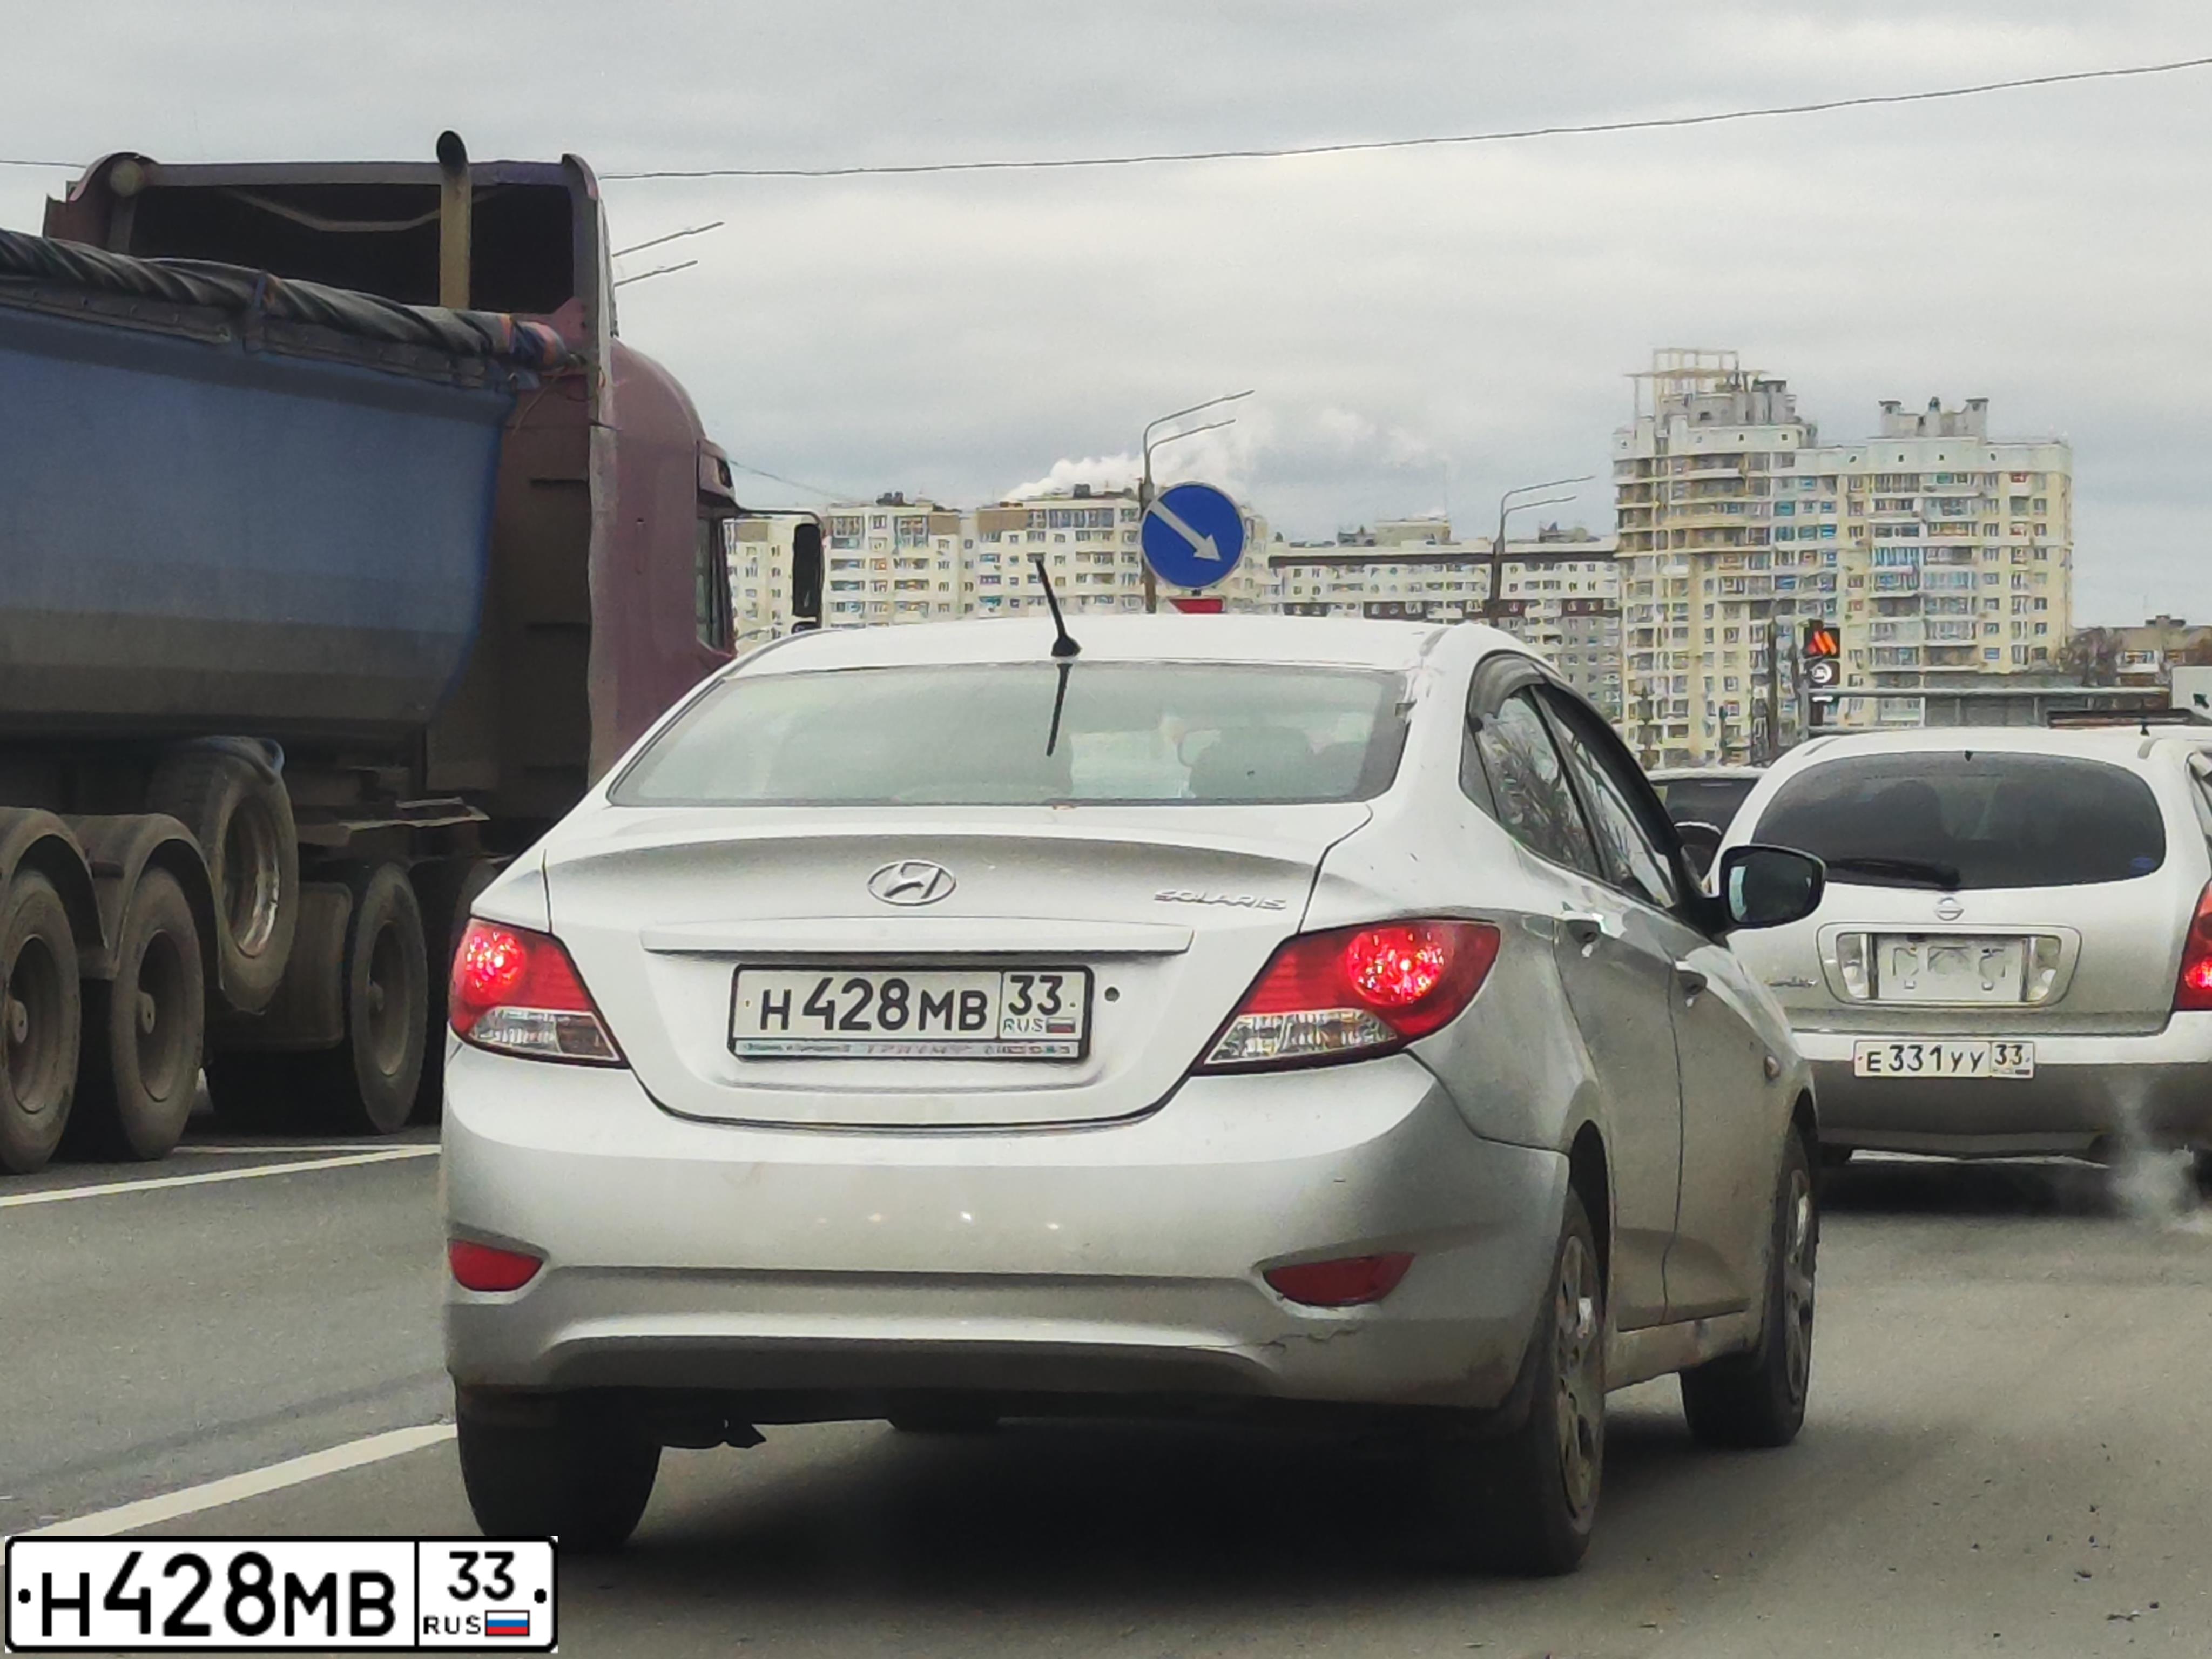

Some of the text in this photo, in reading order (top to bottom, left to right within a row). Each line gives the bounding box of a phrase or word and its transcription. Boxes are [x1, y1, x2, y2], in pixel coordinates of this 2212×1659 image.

[1153, 891, 1287, 911] SOLARIS
[1008, 974, 1063, 1016] 33
[1003, 1018, 1044, 1033] RUS
[1995, 1044, 2023, 1065] 33
